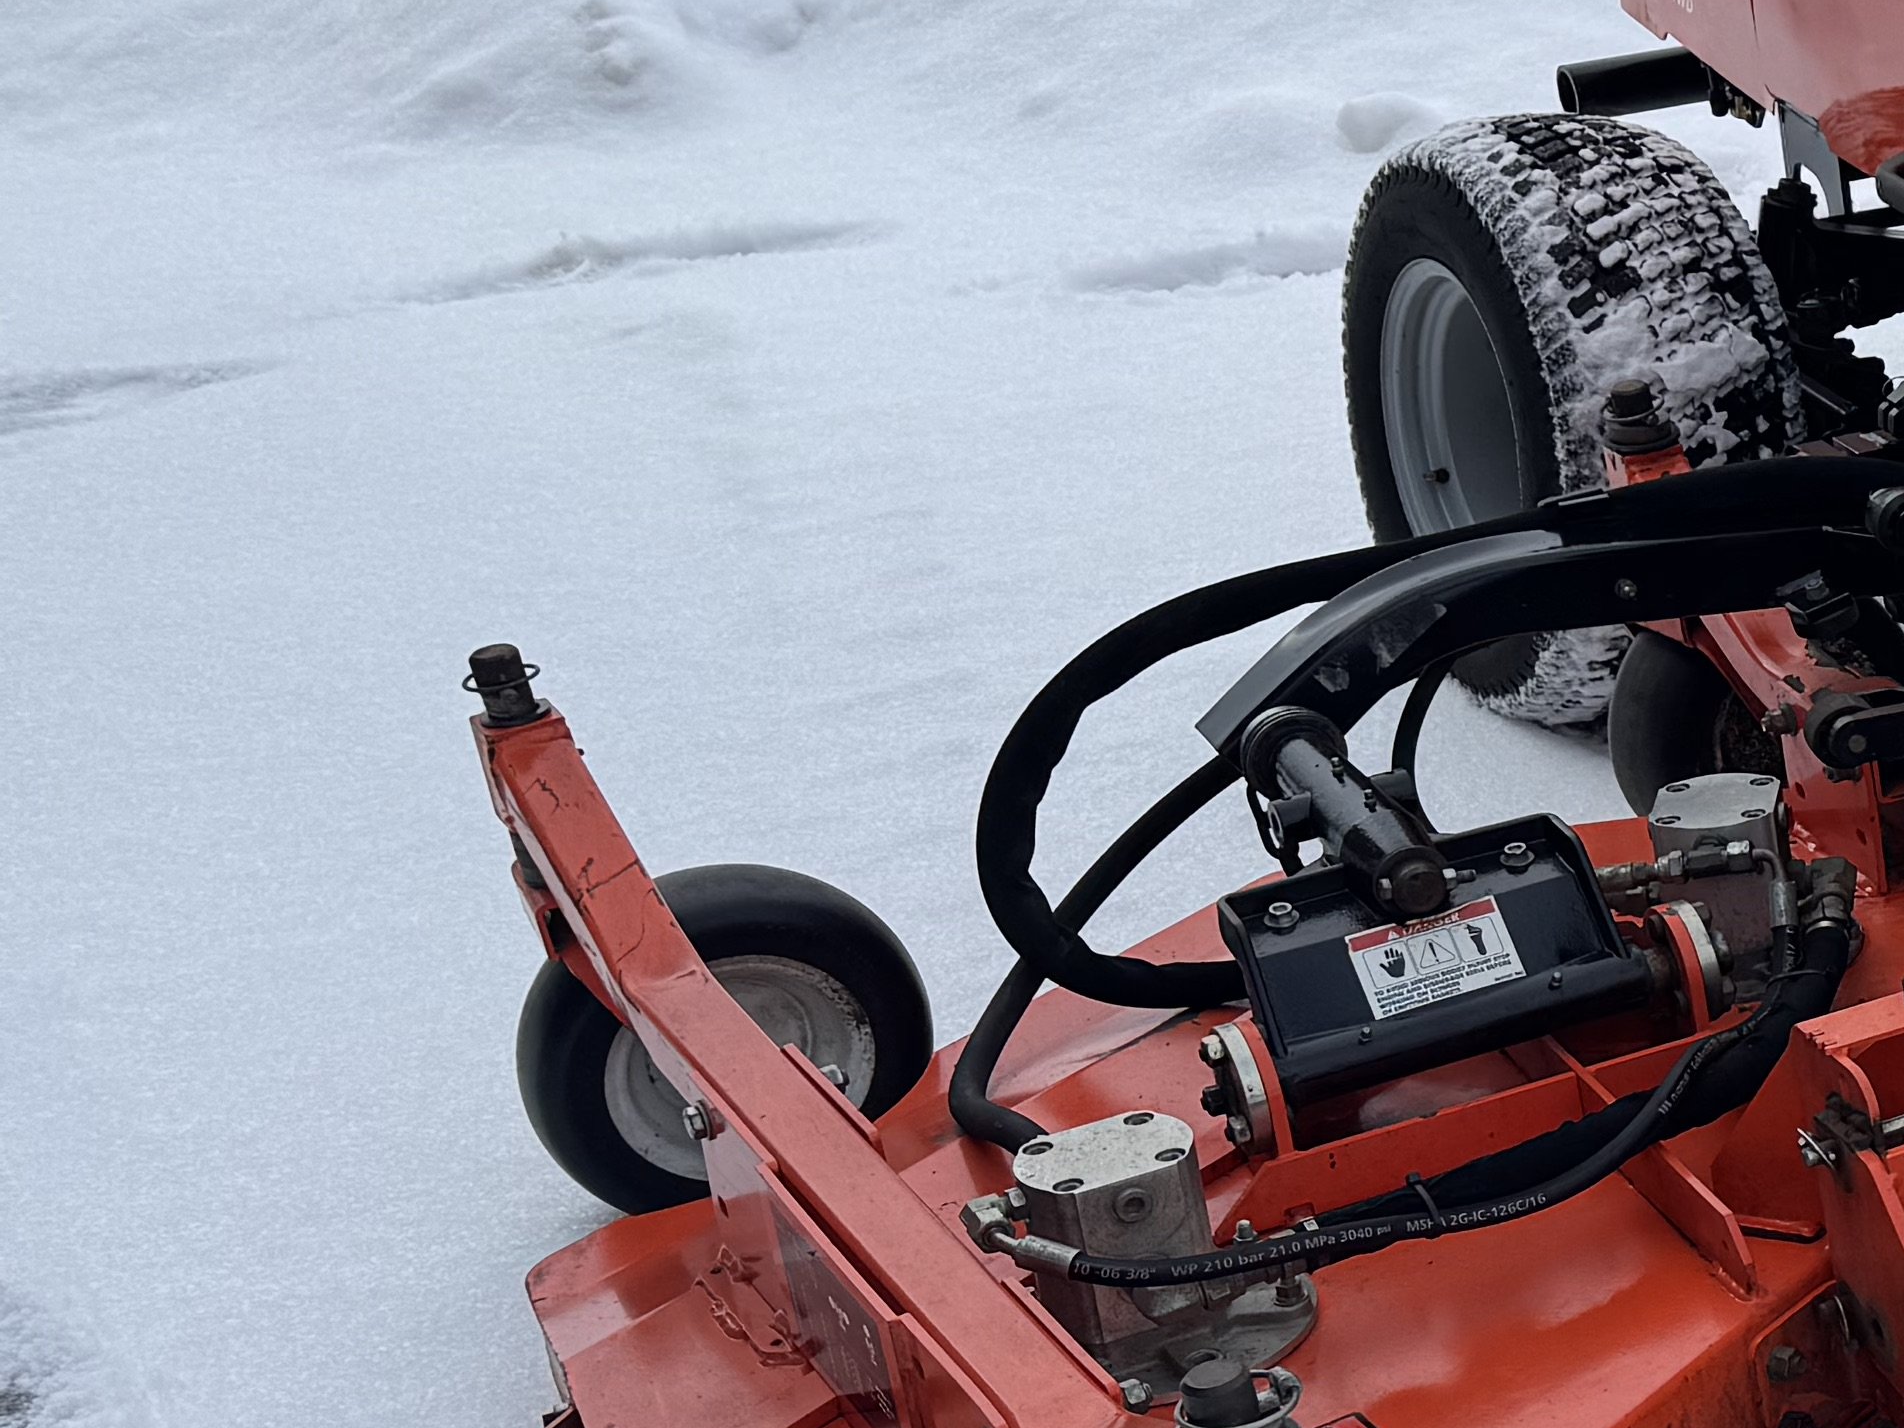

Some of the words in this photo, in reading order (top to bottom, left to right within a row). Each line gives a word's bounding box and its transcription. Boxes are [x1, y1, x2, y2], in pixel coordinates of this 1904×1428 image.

[1170, 1264, 1199, 1277] WP
[1204, 1256, 1233, 1273] 210
[1238, 1250, 1265, 1266] bar
[1269, 1243, 1301, 1260] 21.0
[1305, 1233, 1336, 1250] MPa
[1339, 1226, 1373, 1244] 3040
[1406, 1216, 1448, 1233] MSH
[1450, 1192, 1547, 1227] 2G-IC-126C/16
